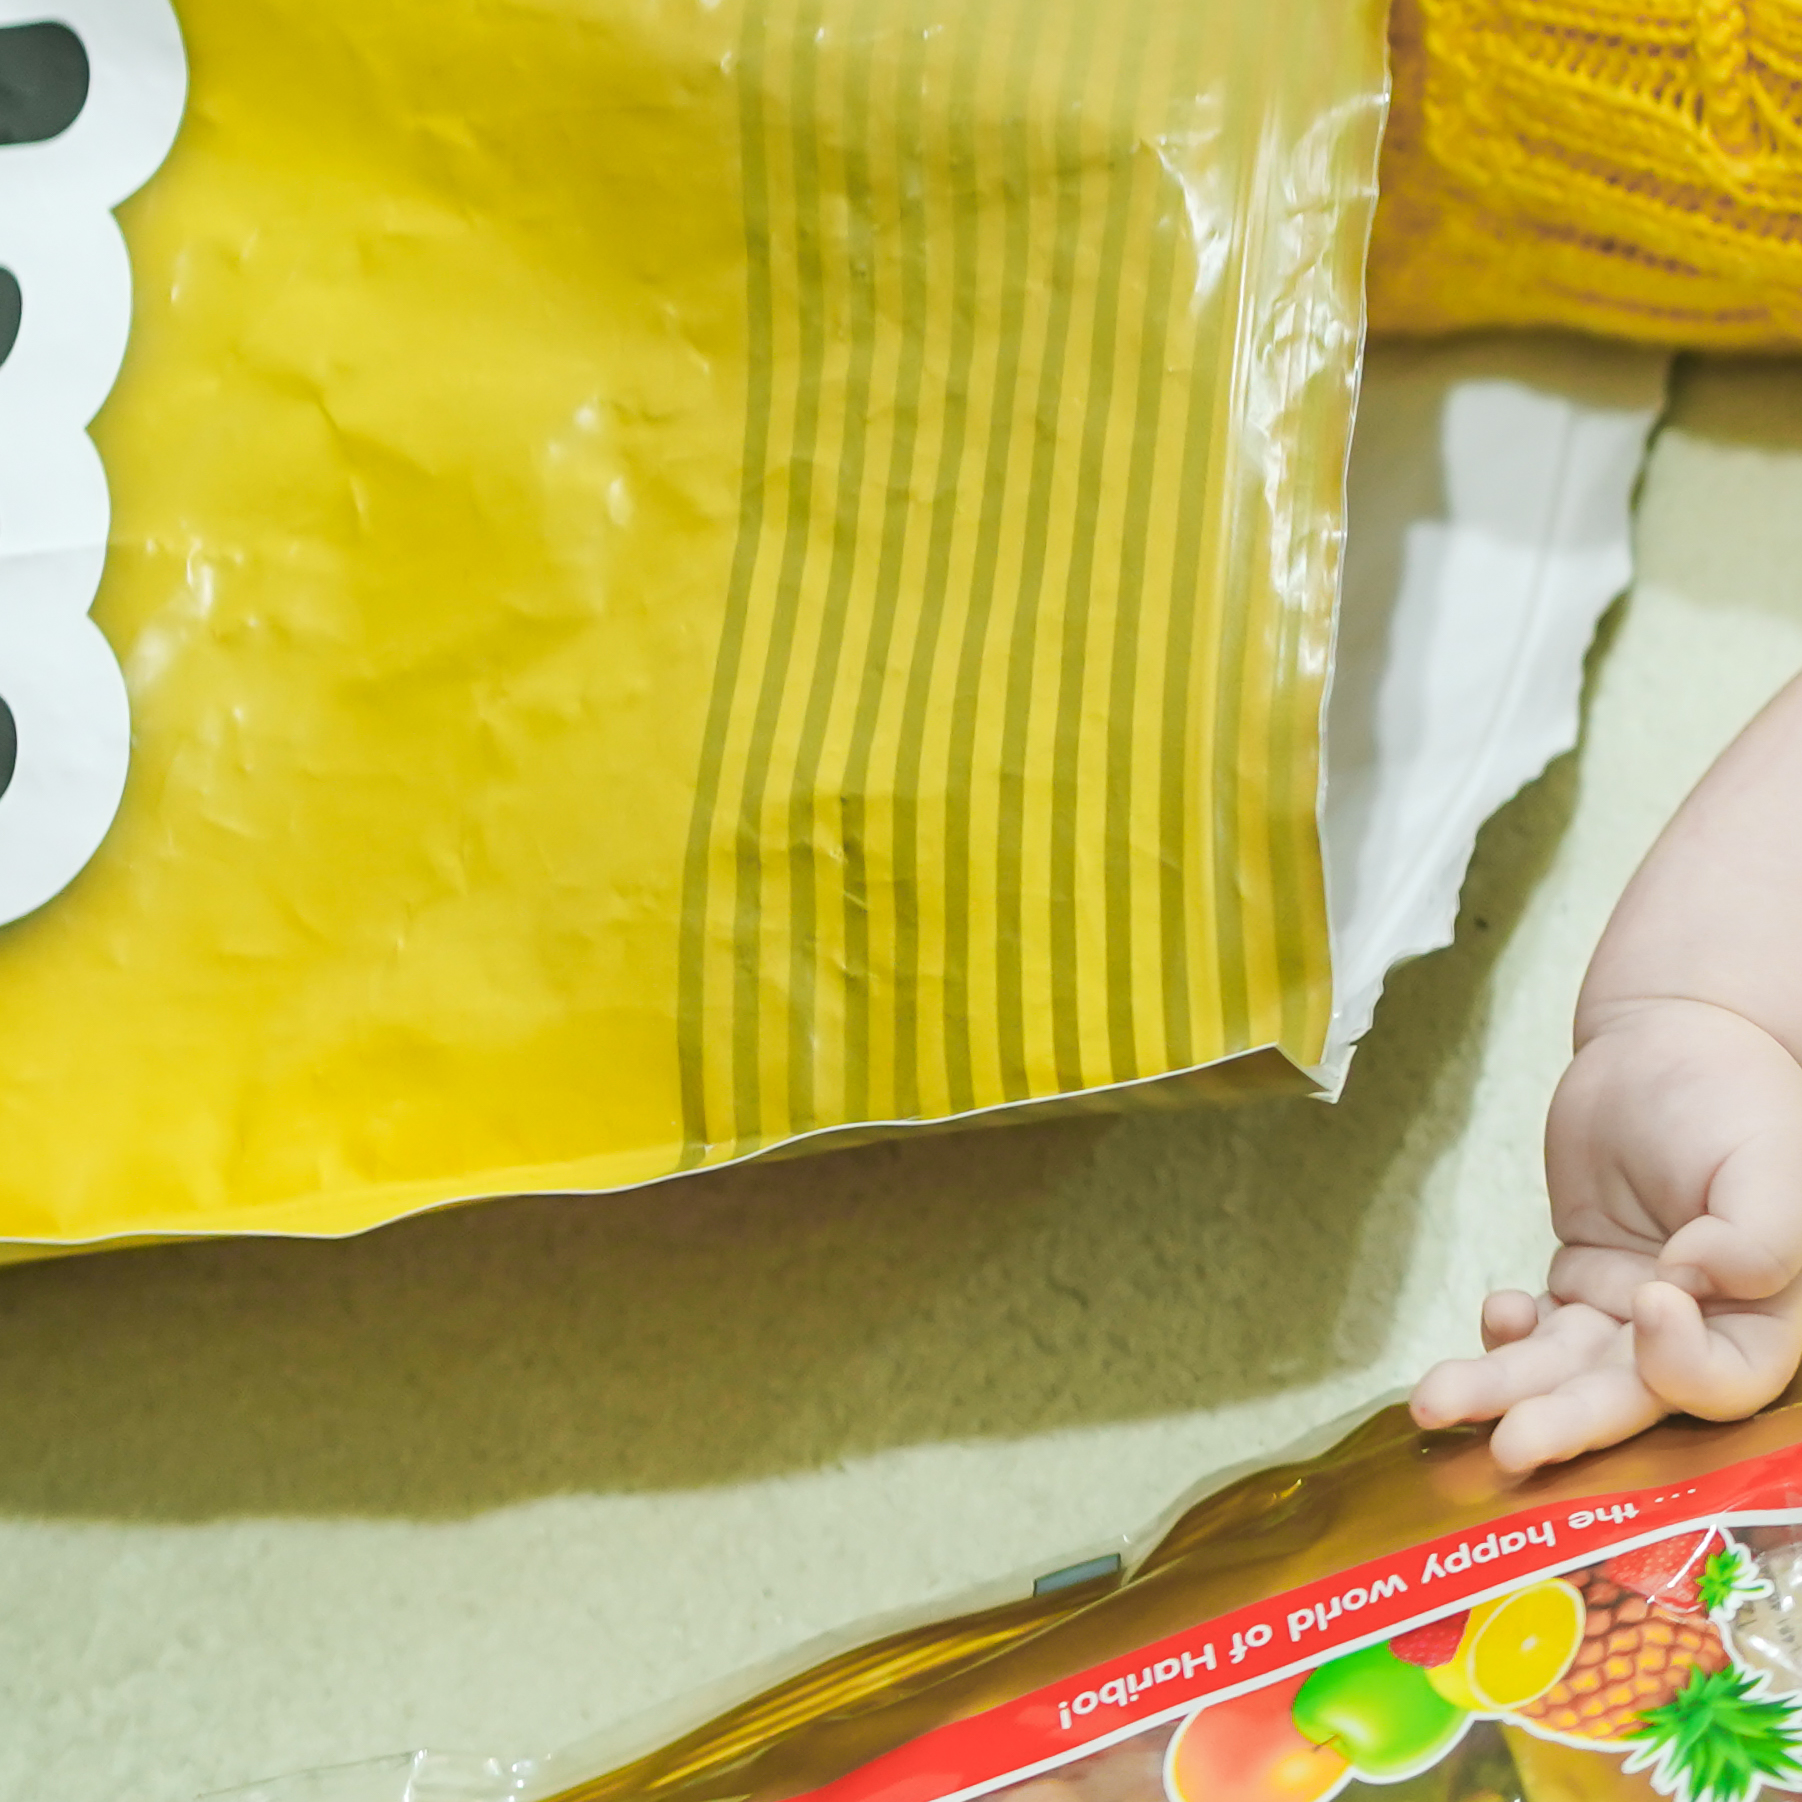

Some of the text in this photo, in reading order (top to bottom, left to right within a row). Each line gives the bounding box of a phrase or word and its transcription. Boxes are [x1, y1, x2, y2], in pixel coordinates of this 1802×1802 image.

[1566, 1501, 1640, 1530] the
[1420, 1519, 1557, 1585] happy
[1286, 1573, 1408, 1643] world
[1229, 1622, 1273, 1665] of
[1057, 1647, 1218, 1731] Haribo!
